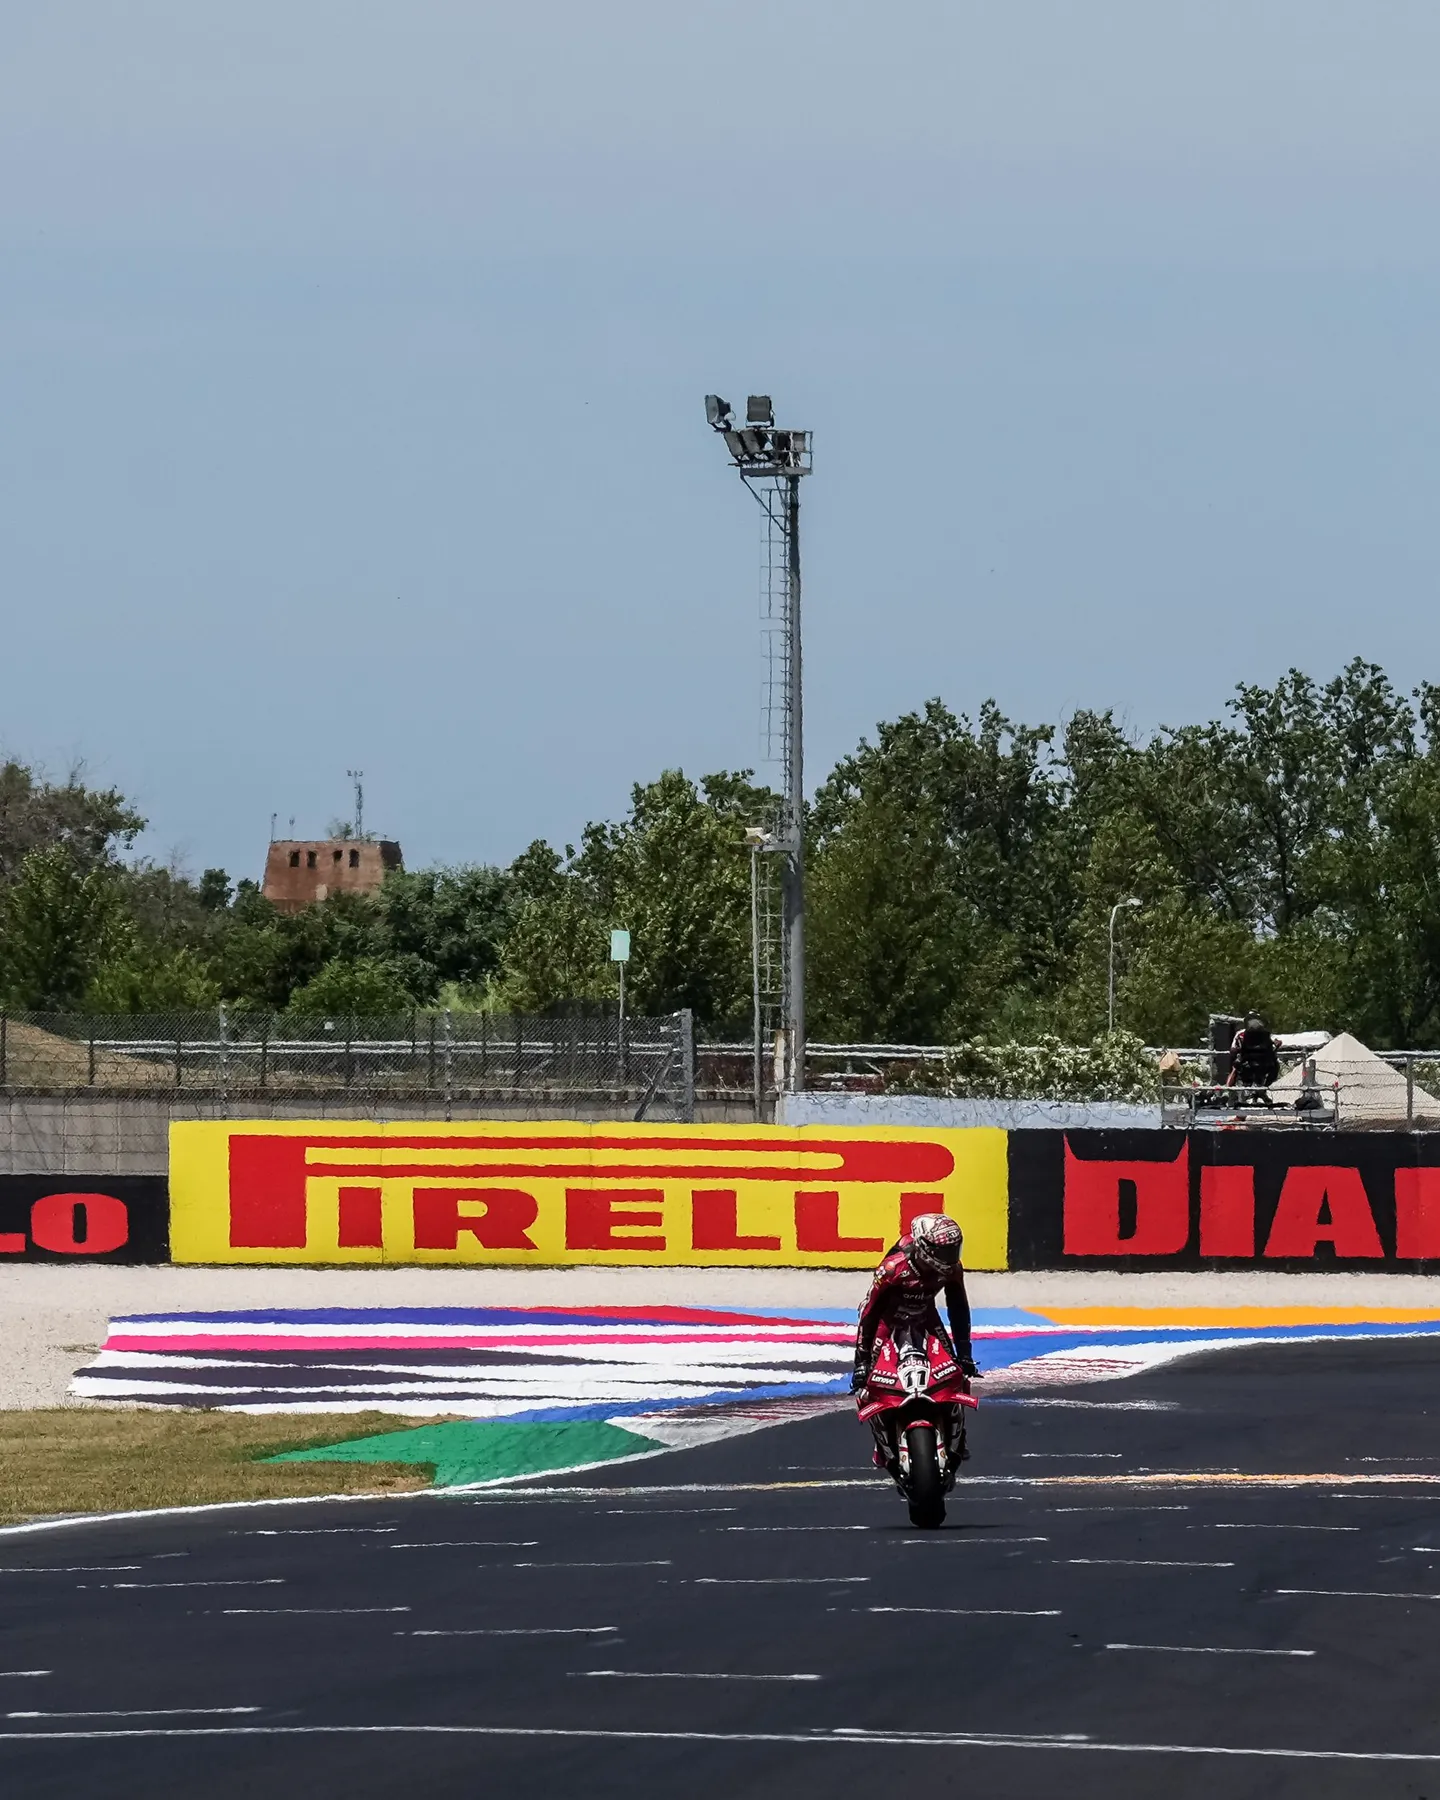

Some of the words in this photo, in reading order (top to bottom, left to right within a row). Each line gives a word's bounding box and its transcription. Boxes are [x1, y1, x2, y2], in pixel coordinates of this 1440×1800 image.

[871, 1374, 896, 1385] Lenovo
[904, 1370, 927, 1389] 11
[933, 1365, 957, 1380] Lenovo
